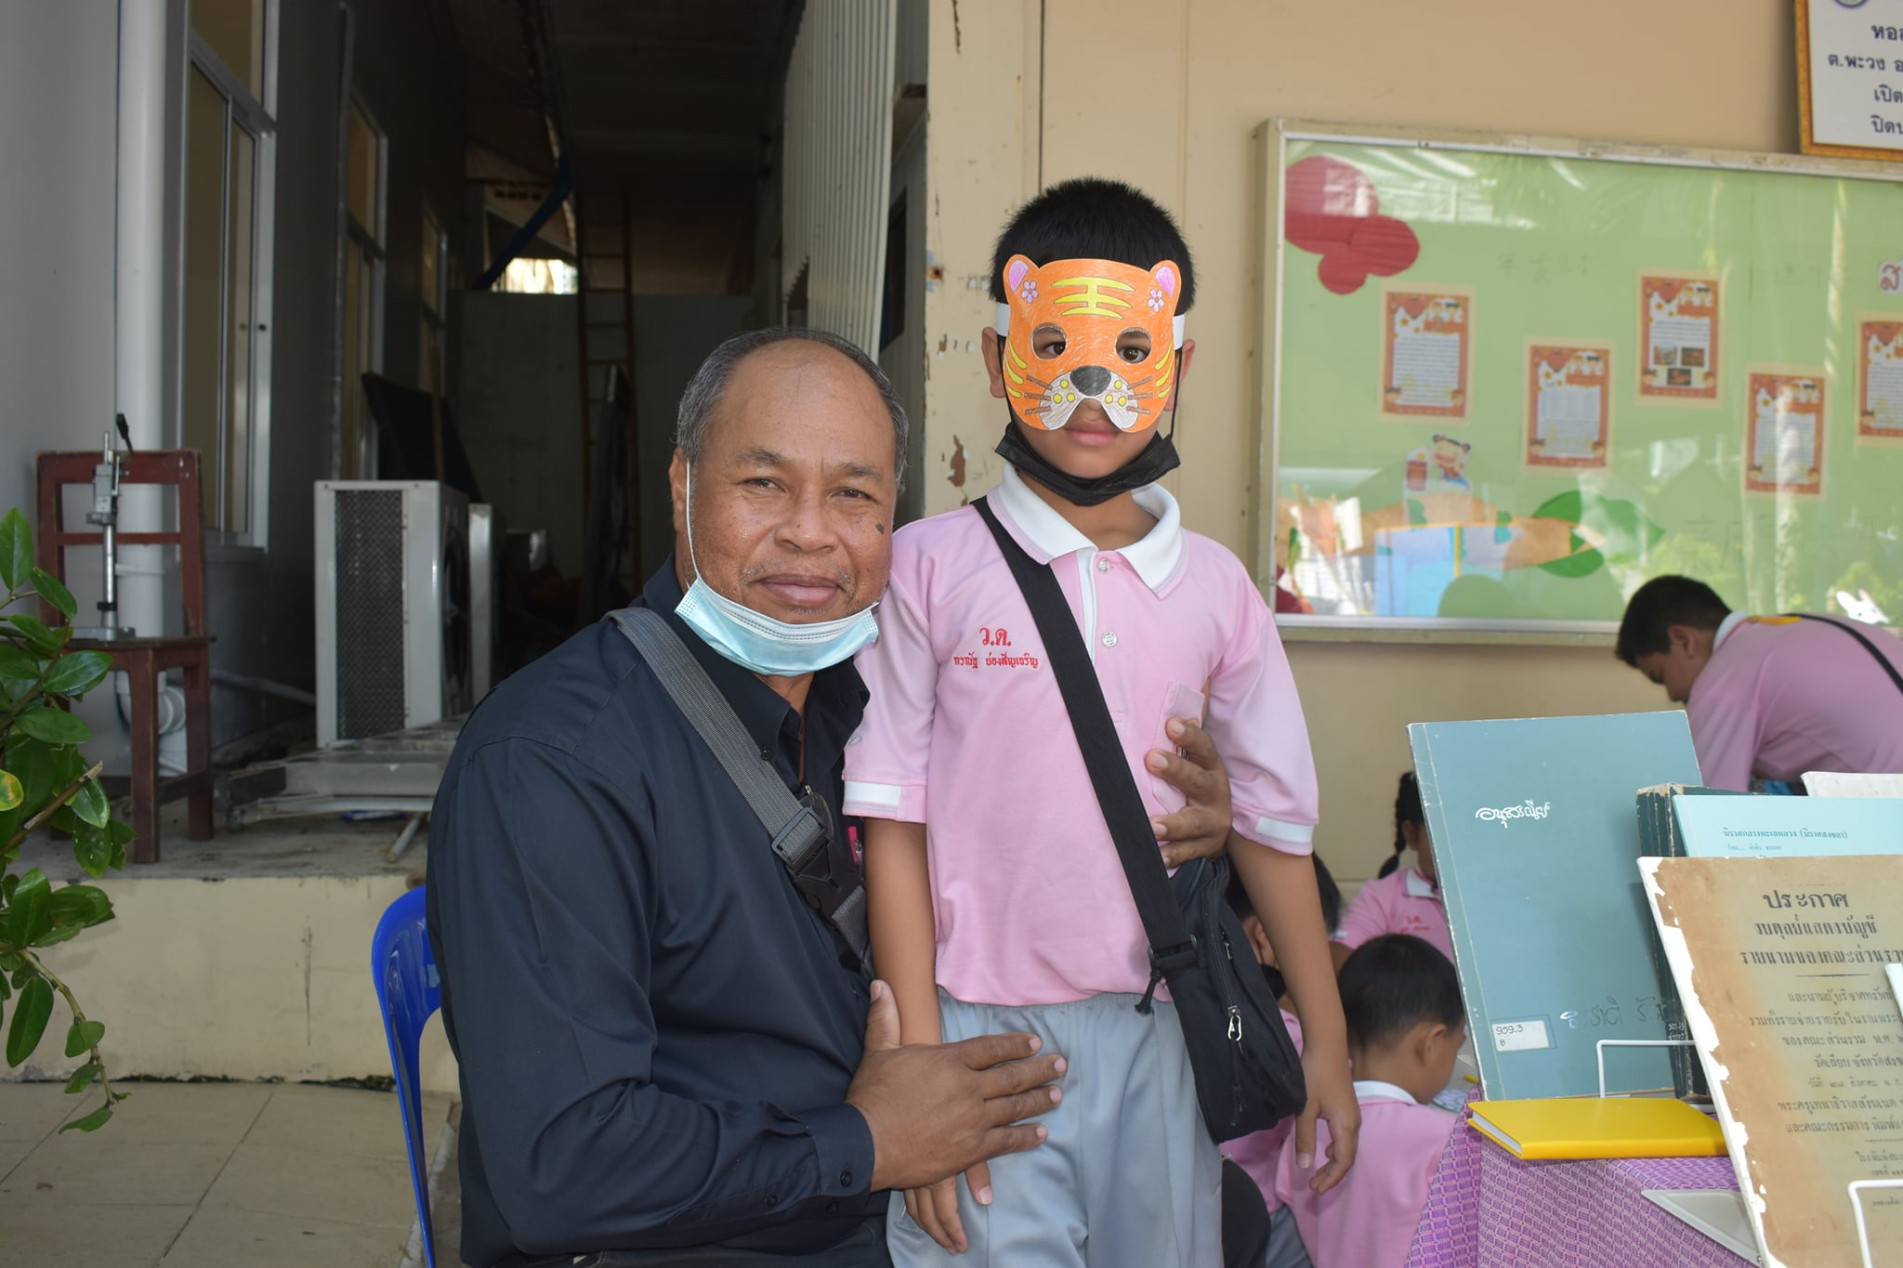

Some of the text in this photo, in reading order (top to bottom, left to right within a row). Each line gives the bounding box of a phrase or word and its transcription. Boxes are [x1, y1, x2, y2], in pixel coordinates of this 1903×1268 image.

[1828, 54, 1885, 71] ต.พะวง
[1762, 889, 1849, 909] ประกาศ
